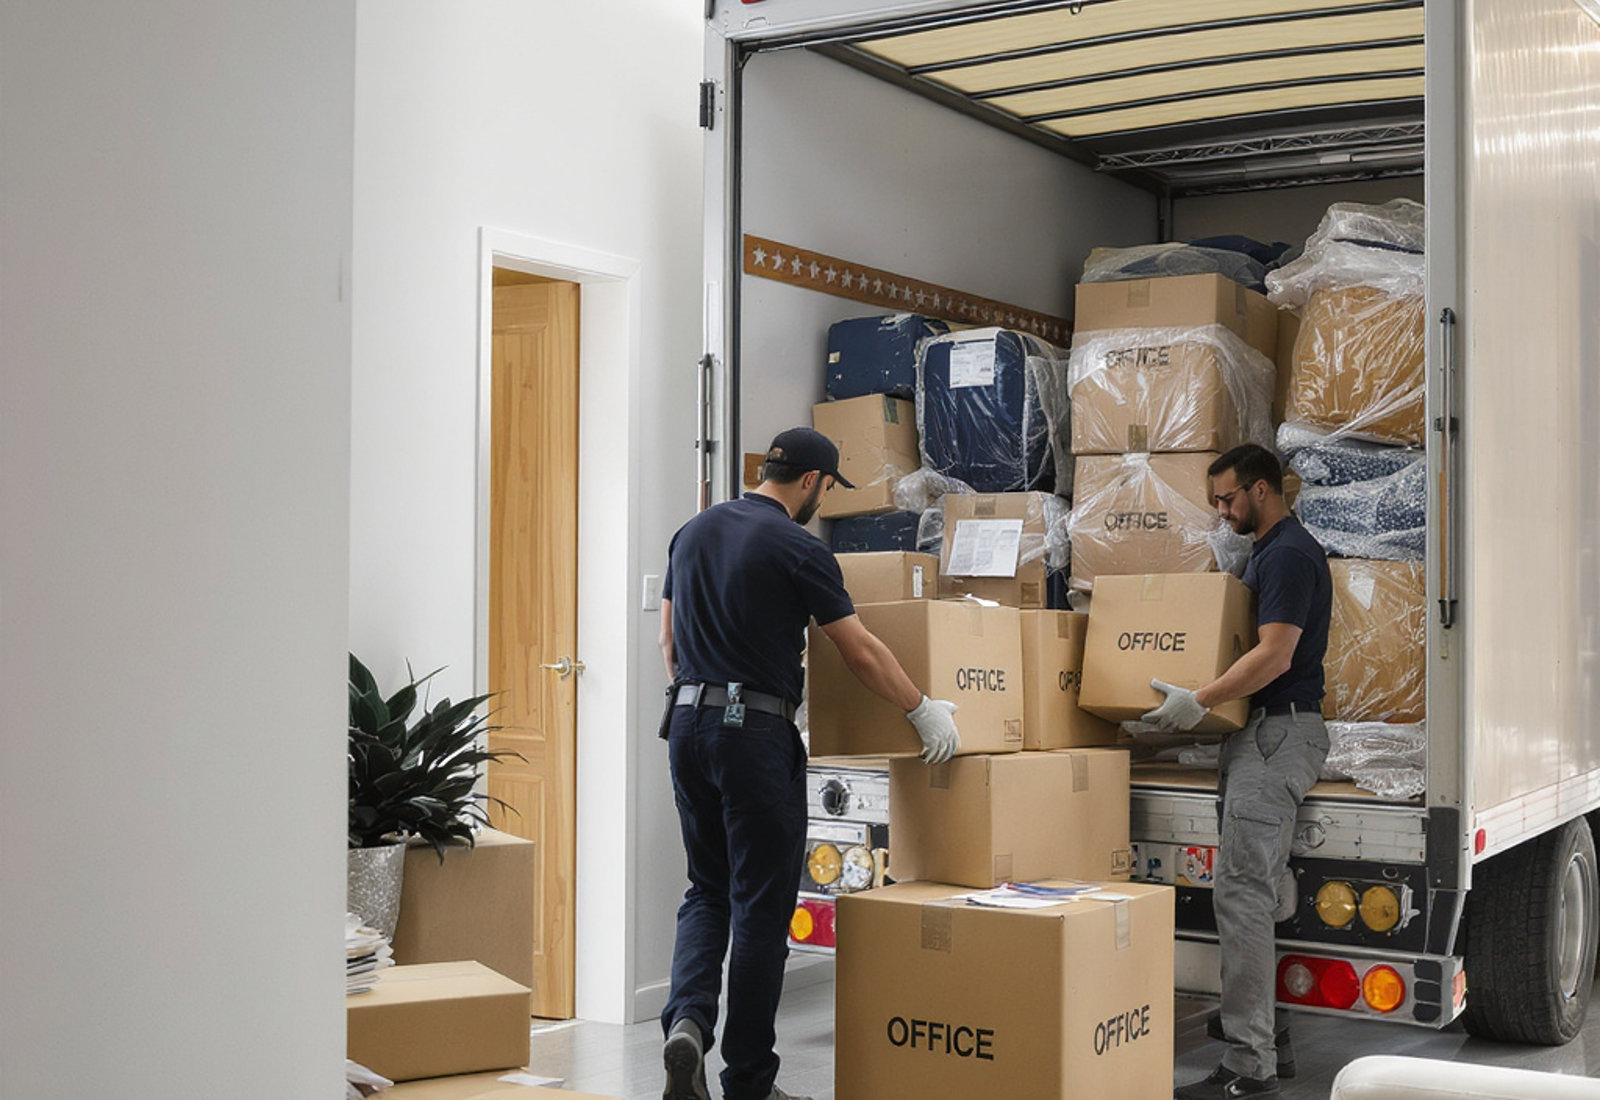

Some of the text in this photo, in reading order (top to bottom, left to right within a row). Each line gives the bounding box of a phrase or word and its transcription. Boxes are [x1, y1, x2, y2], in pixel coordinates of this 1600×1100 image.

[1118, 632, 1186, 651] OFFICE
[956, 668, 1006, 692] OFFICE
[887, 1016, 994, 1061] OFFICE
[1093, 1004, 1150, 1055] OFFICE
